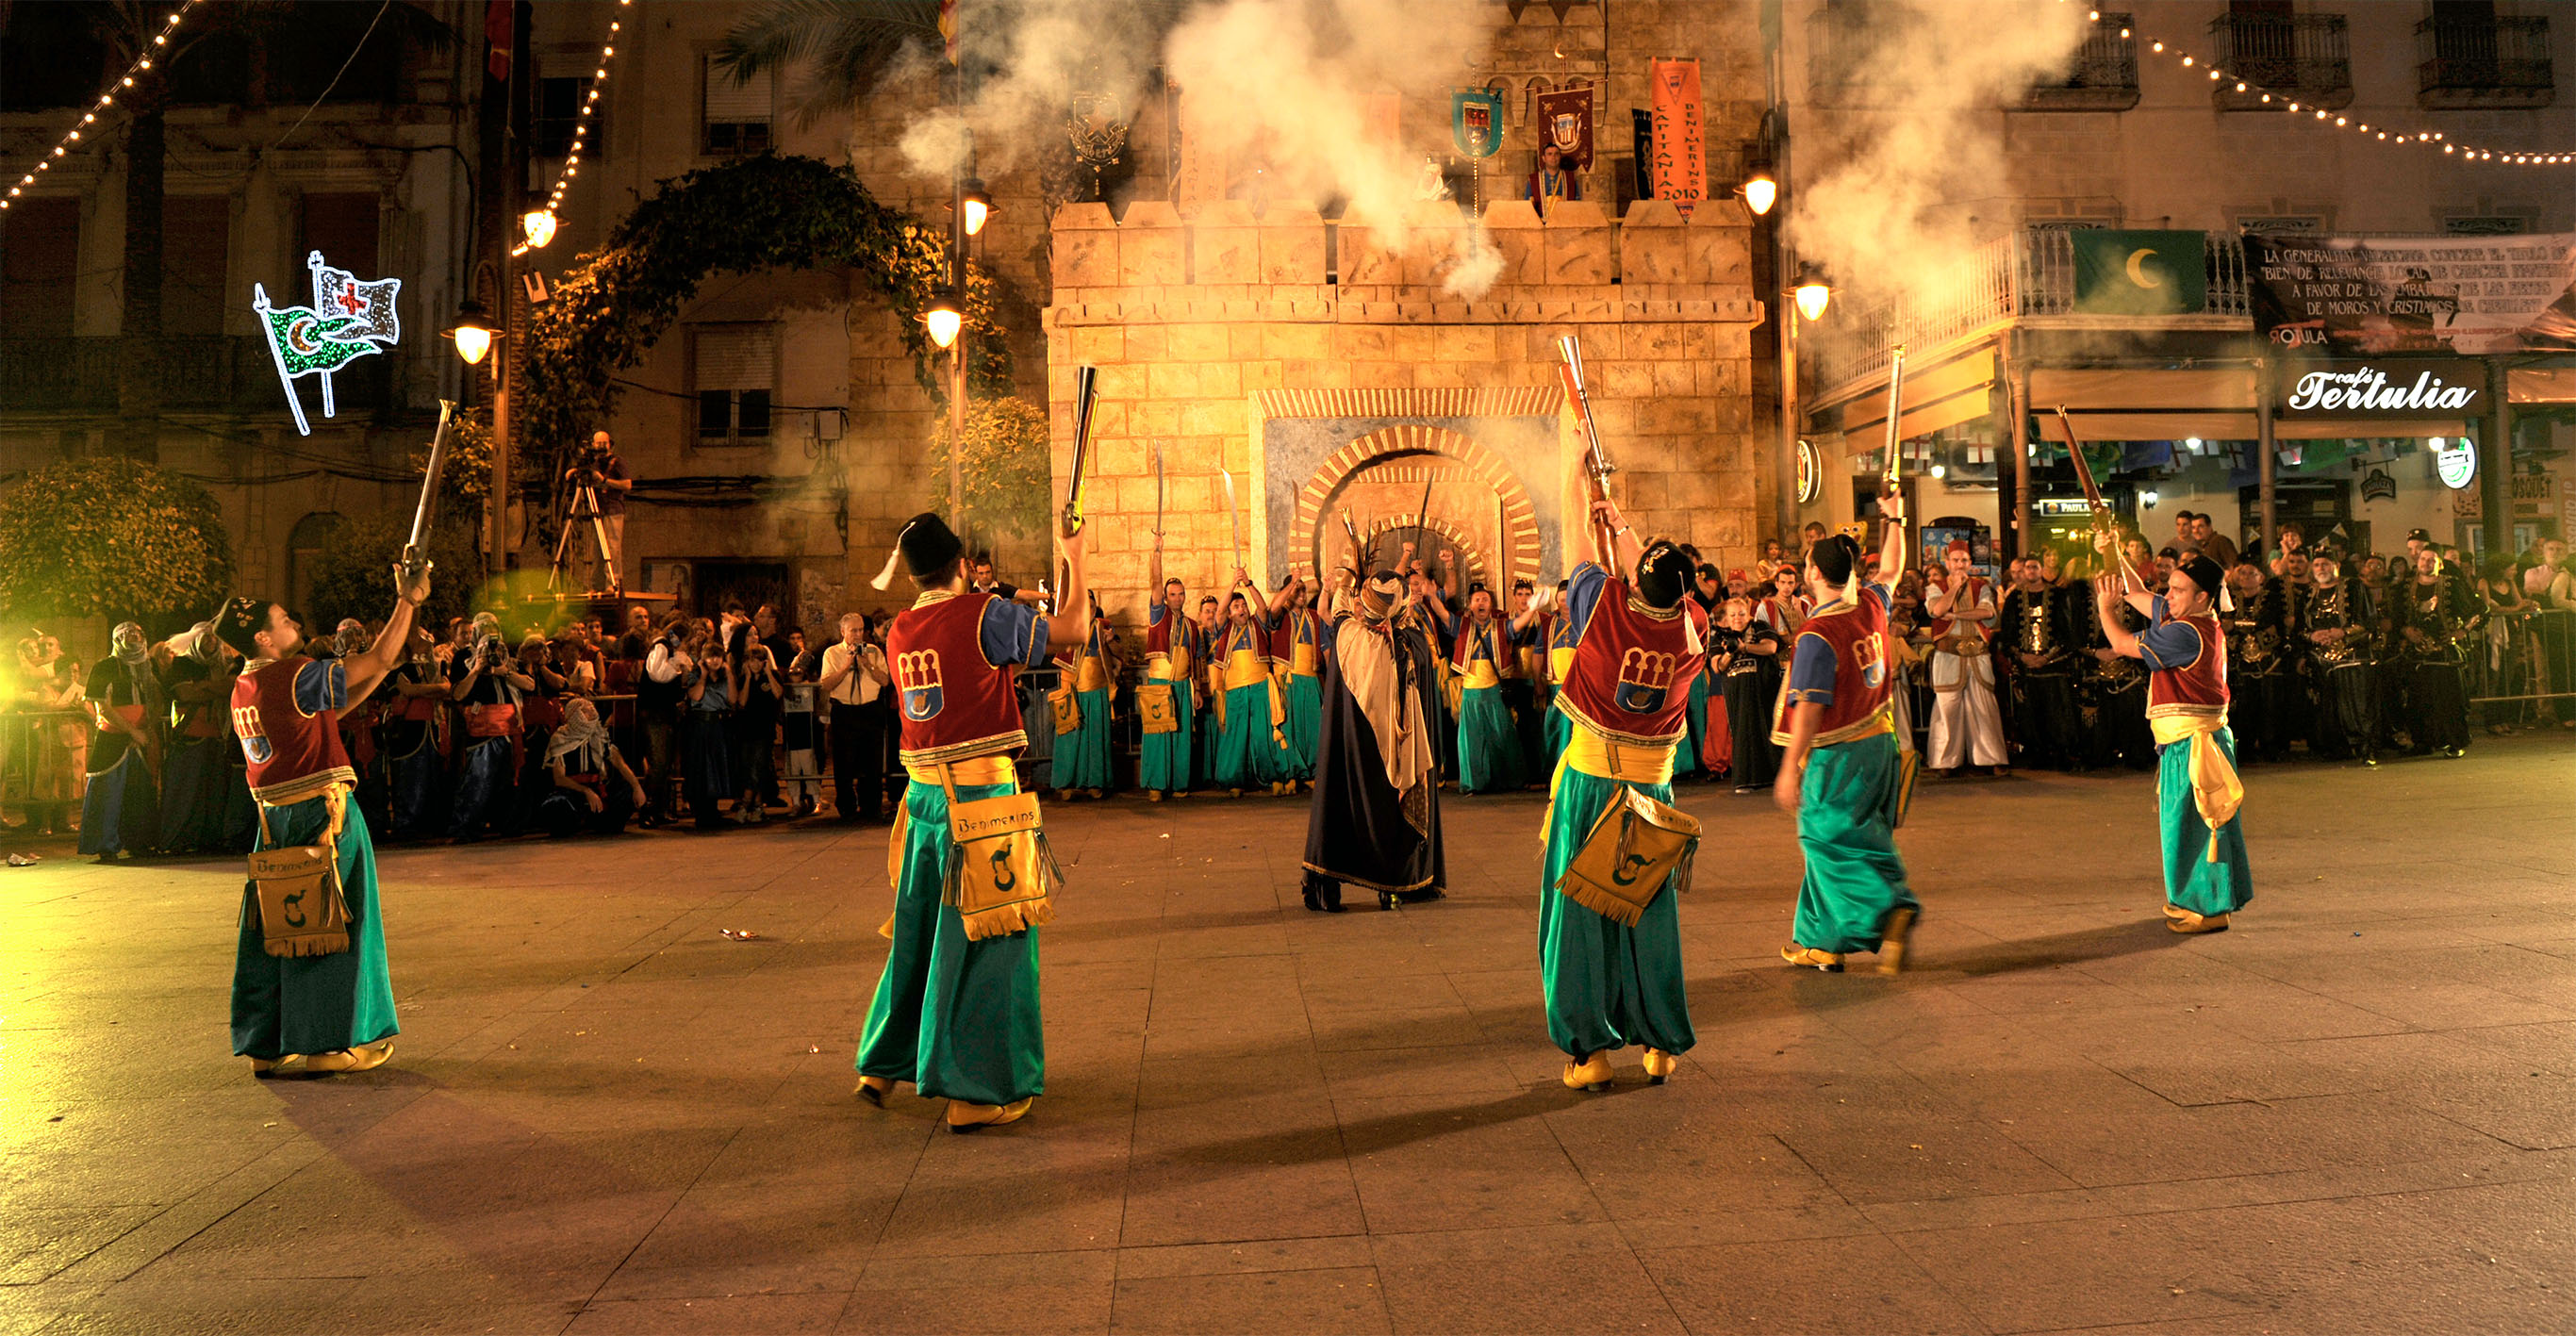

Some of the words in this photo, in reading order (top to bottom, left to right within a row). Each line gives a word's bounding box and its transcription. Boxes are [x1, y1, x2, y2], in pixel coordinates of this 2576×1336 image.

[1656, 105, 1674, 188] CAPITANIA
[1685, 103, 1700, 187] BENIMERINS
[1663, 189, 1700, 201] 2010
[2264, 249, 2279, 263] LA
[2284, 249, 2355, 263] GENERALITAT
[2297, 266, 2314, 280] DE
[2319, 266, 2386, 280] RELEVANCIA
[2293, 284, 2302, 298] A
[2306, 284, 2341, 298] FAVOR
[2346, 284, 2363, 297] DE
[2307, 301, 2323, 316] DE
[2328, 301, 2370, 315] MOROS
[2373, 301, 2382, 314] Y
[2386, 300, 2453, 315] CRISTIANOS
[2336, 366, 2374, 388] café
[2288, 371, 2477, 410] Tertulia
[2511, 476, 2551, 499] OSQUET
[2060, 503, 2109, 513] PAULA
